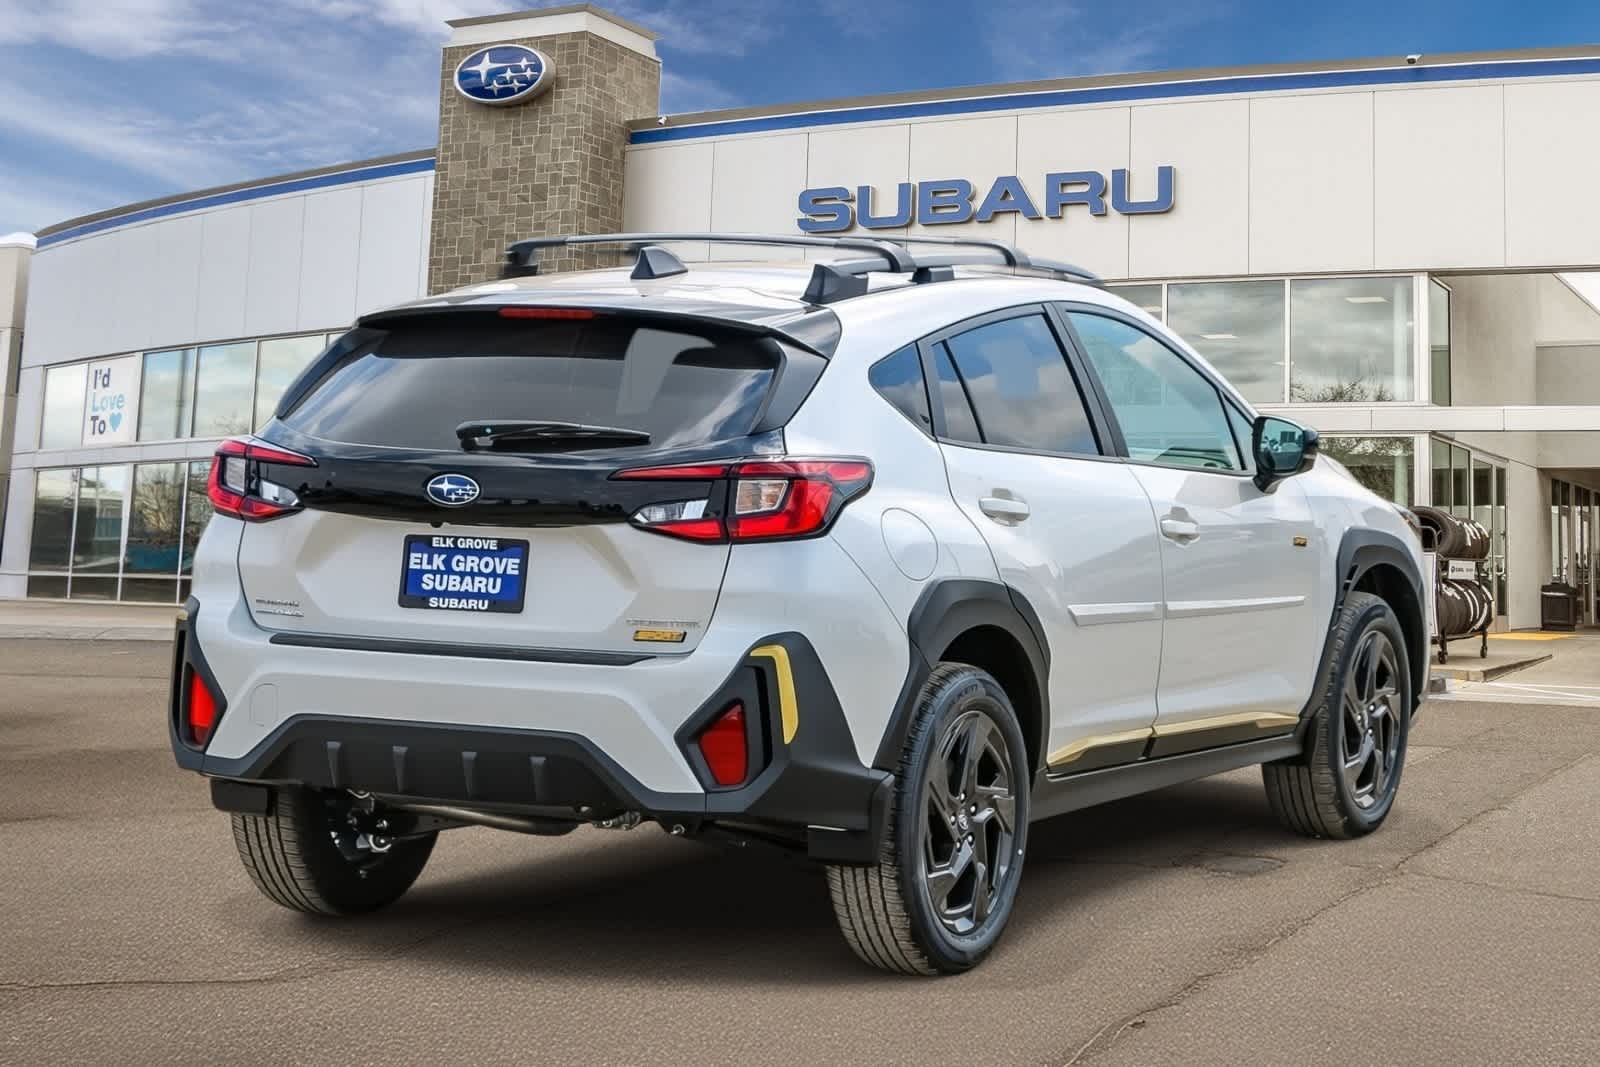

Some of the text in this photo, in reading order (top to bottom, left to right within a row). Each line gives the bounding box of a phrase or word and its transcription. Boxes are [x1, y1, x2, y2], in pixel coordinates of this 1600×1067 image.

[797, 165, 1175, 233] SUBARU
[94, 367, 111, 389] I'd
[92, 391, 125, 412] Love
[91, 415, 106, 435] To
[432, 536, 498, 550] ELK GROVE
[409, 552, 520, 575] ELK GROVE
[421, 573, 501, 594] SUBARU
[429, 597, 489, 610] SUBARU
